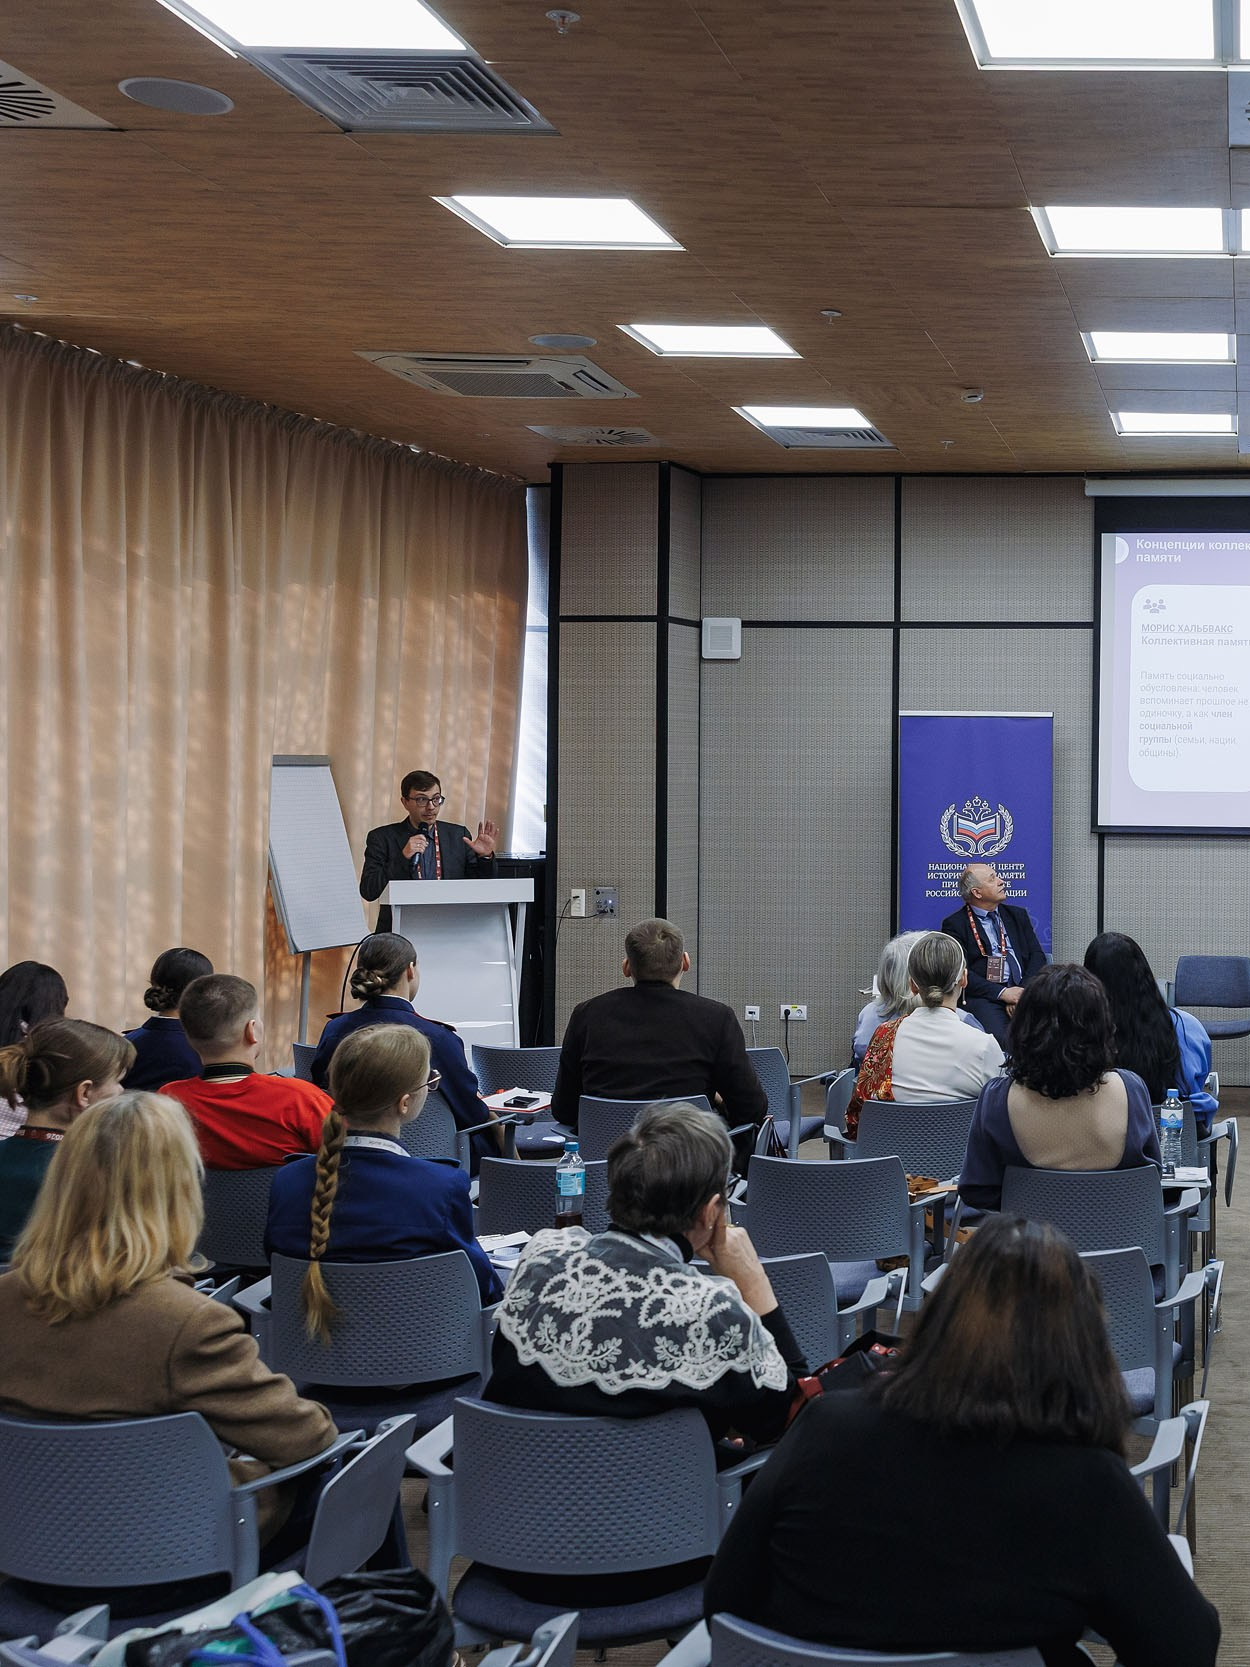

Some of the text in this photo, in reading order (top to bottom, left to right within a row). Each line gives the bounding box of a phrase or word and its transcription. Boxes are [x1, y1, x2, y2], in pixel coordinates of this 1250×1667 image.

[1136, 538, 1206, 551] Концепции
[1136, 553, 1182, 563] памяти
[1141, 624, 1234, 634] МОРИС ХАЛЬБВАКС
[1141, 636, 1215, 647] Коллективная
[1140, 671, 1225, 682] Память социально
[1202, 685, 1238, 693] человек
[1139, 697, 1194, 706] вспоминает
[1196, 698, 1236, 708] прошлое
[1238, 698, 1249, 706] не
[1139, 721, 1193, 731] социальной
[1139, 736, 1172, 745] группы
[998, 863, 1025, 871] ЦЕНТР
